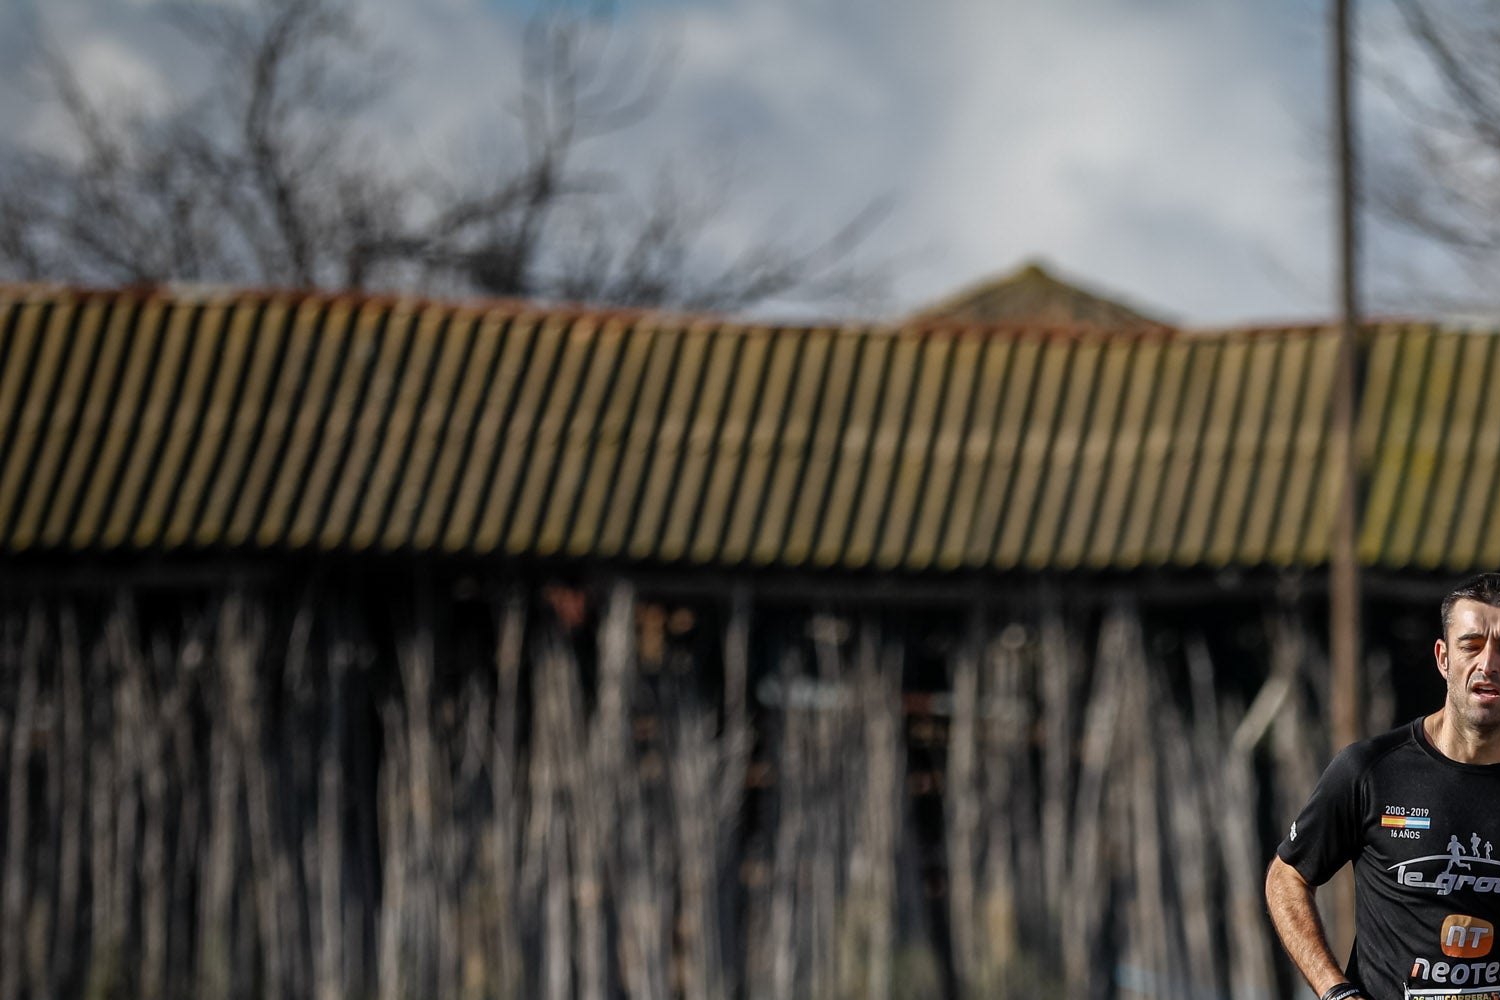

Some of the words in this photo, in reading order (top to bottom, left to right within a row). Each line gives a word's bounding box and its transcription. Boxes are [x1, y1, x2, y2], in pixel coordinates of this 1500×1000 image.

[1385, 805, 1429, 817] 2003-2019
[1390, 829, 1398, 838] 16
[1398, 829, 1421, 840] AÑOS
